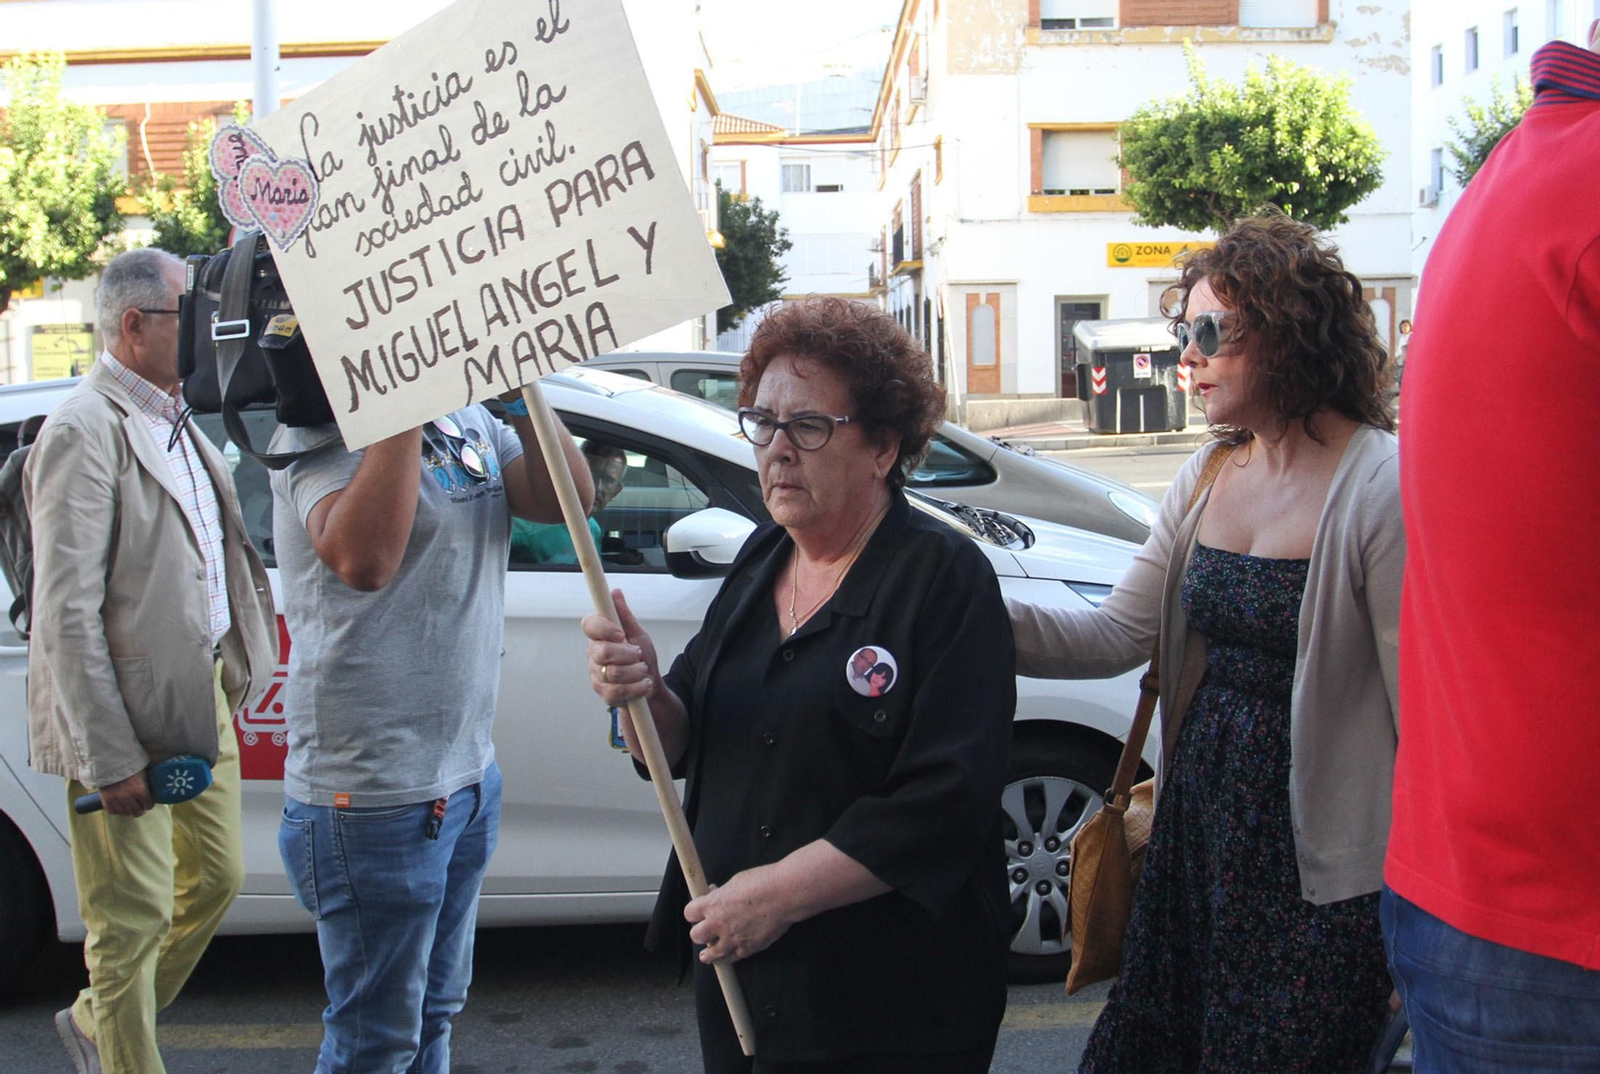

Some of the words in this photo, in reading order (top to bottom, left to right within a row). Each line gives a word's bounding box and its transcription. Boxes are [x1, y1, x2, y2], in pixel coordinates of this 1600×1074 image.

[300, 111, 343, 183] La
[356, 72, 473, 167] justicia
[485, 41, 518, 73] es
[534, 0, 570, 43] el
[372, 124, 461, 215] final
[471, 100, 510, 146] de
[516, 70, 567, 117] la
[343, 204, 525, 330] JUSTICIA
[544, 140, 655, 228] PARA
[355, 171, 483, 257] sociedad
[499, 119, 575, 186] civil.
[1136, 245, 1171, 255] ZONA
[340, 299, 478, 412] MIGUEL
[480, 239, 620, 336] ANGEL
[627, 221, 657, 275] Y
[464, 301, 618, 407] MARIA
